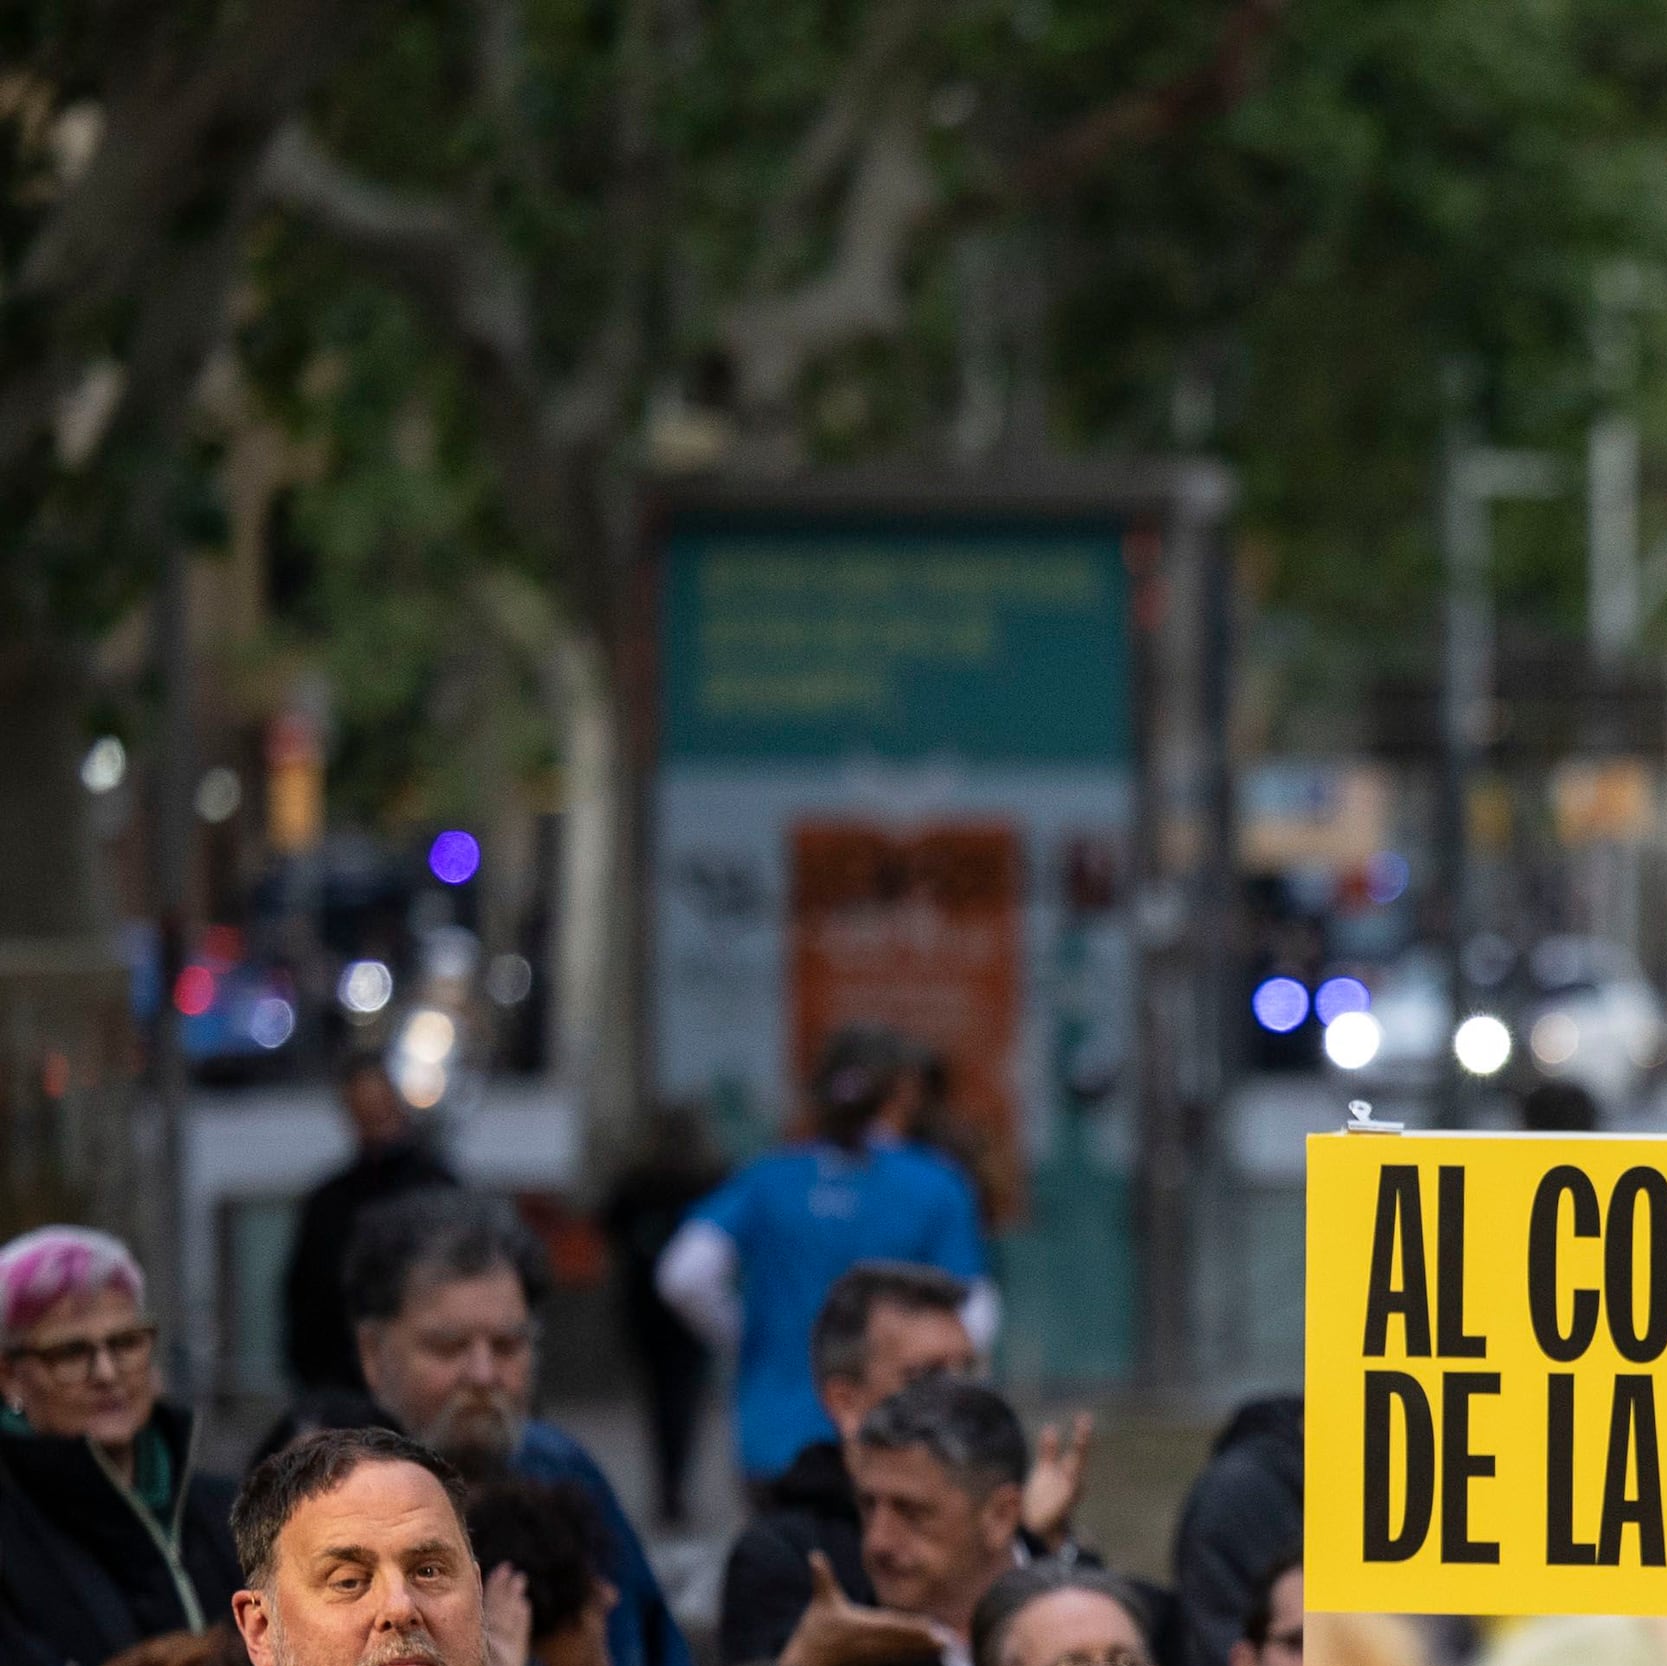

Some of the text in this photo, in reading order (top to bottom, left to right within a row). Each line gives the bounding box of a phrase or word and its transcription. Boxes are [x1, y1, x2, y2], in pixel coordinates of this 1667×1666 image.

[1362, 1165, 1487, 1359] AL
[1362, 1371, 1502, 1565] DE
[1546, 1373, 1667, 1568] LA
